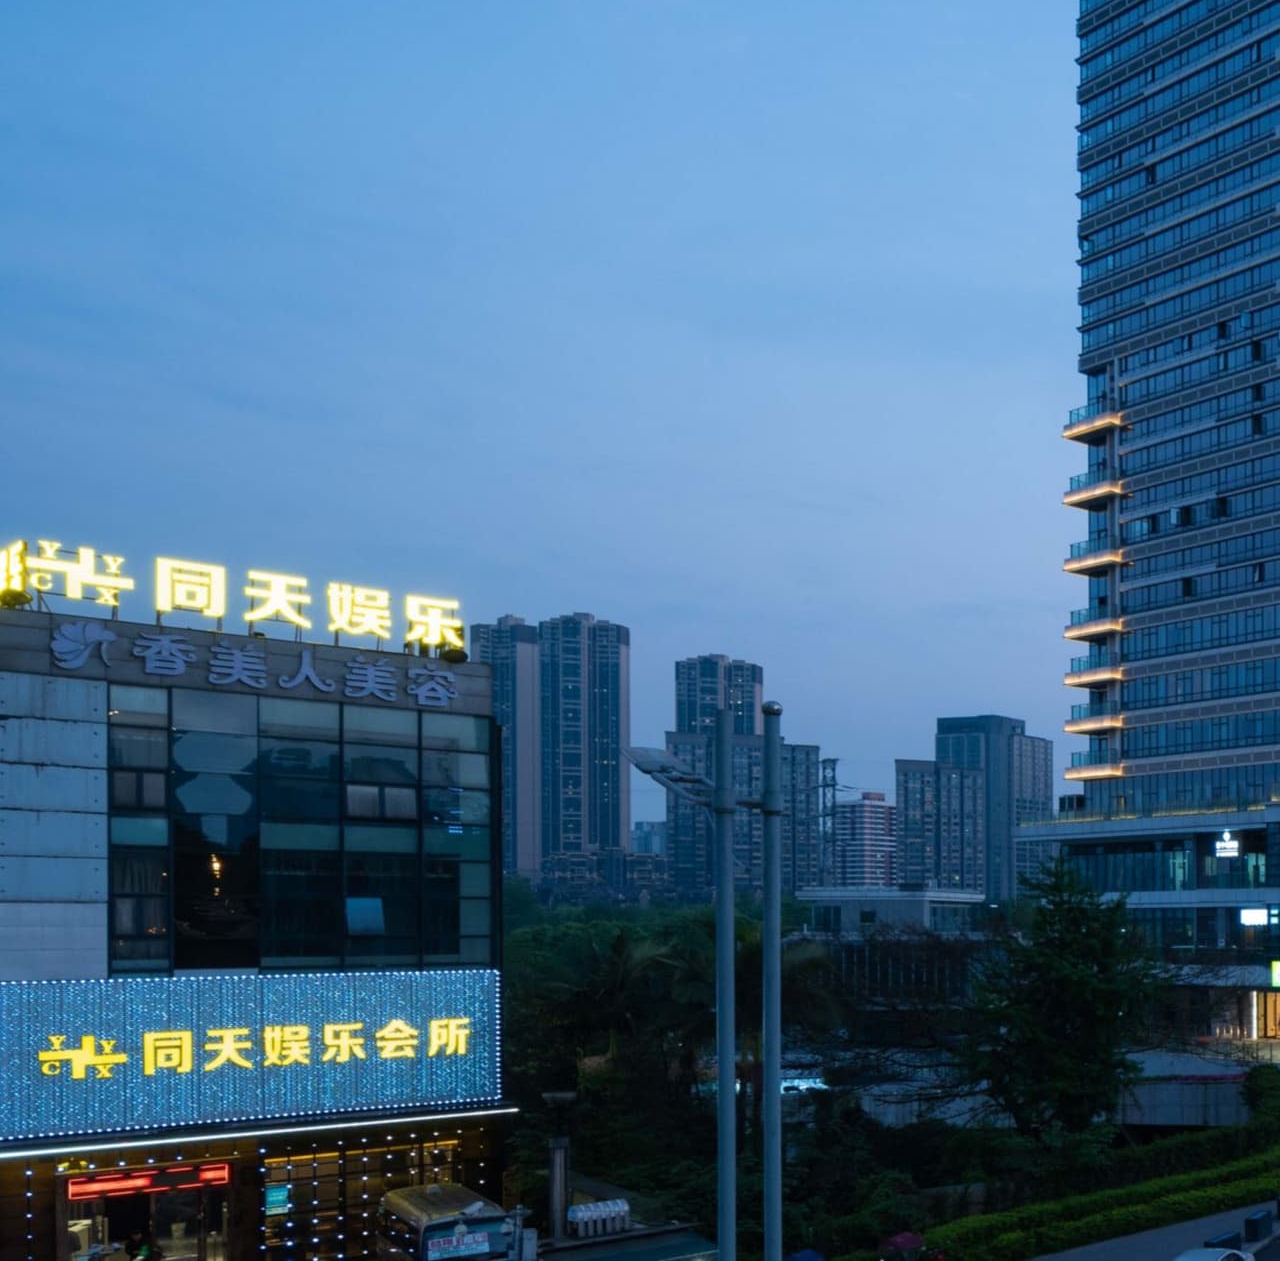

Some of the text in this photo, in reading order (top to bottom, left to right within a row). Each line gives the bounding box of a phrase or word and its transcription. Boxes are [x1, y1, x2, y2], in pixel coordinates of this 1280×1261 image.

[155, 556, 465, 647] 同天娱乐
[133, 633, 459, 707] 香美人美容
[143, 1017, 471, 1076] 同天娱乐会所
